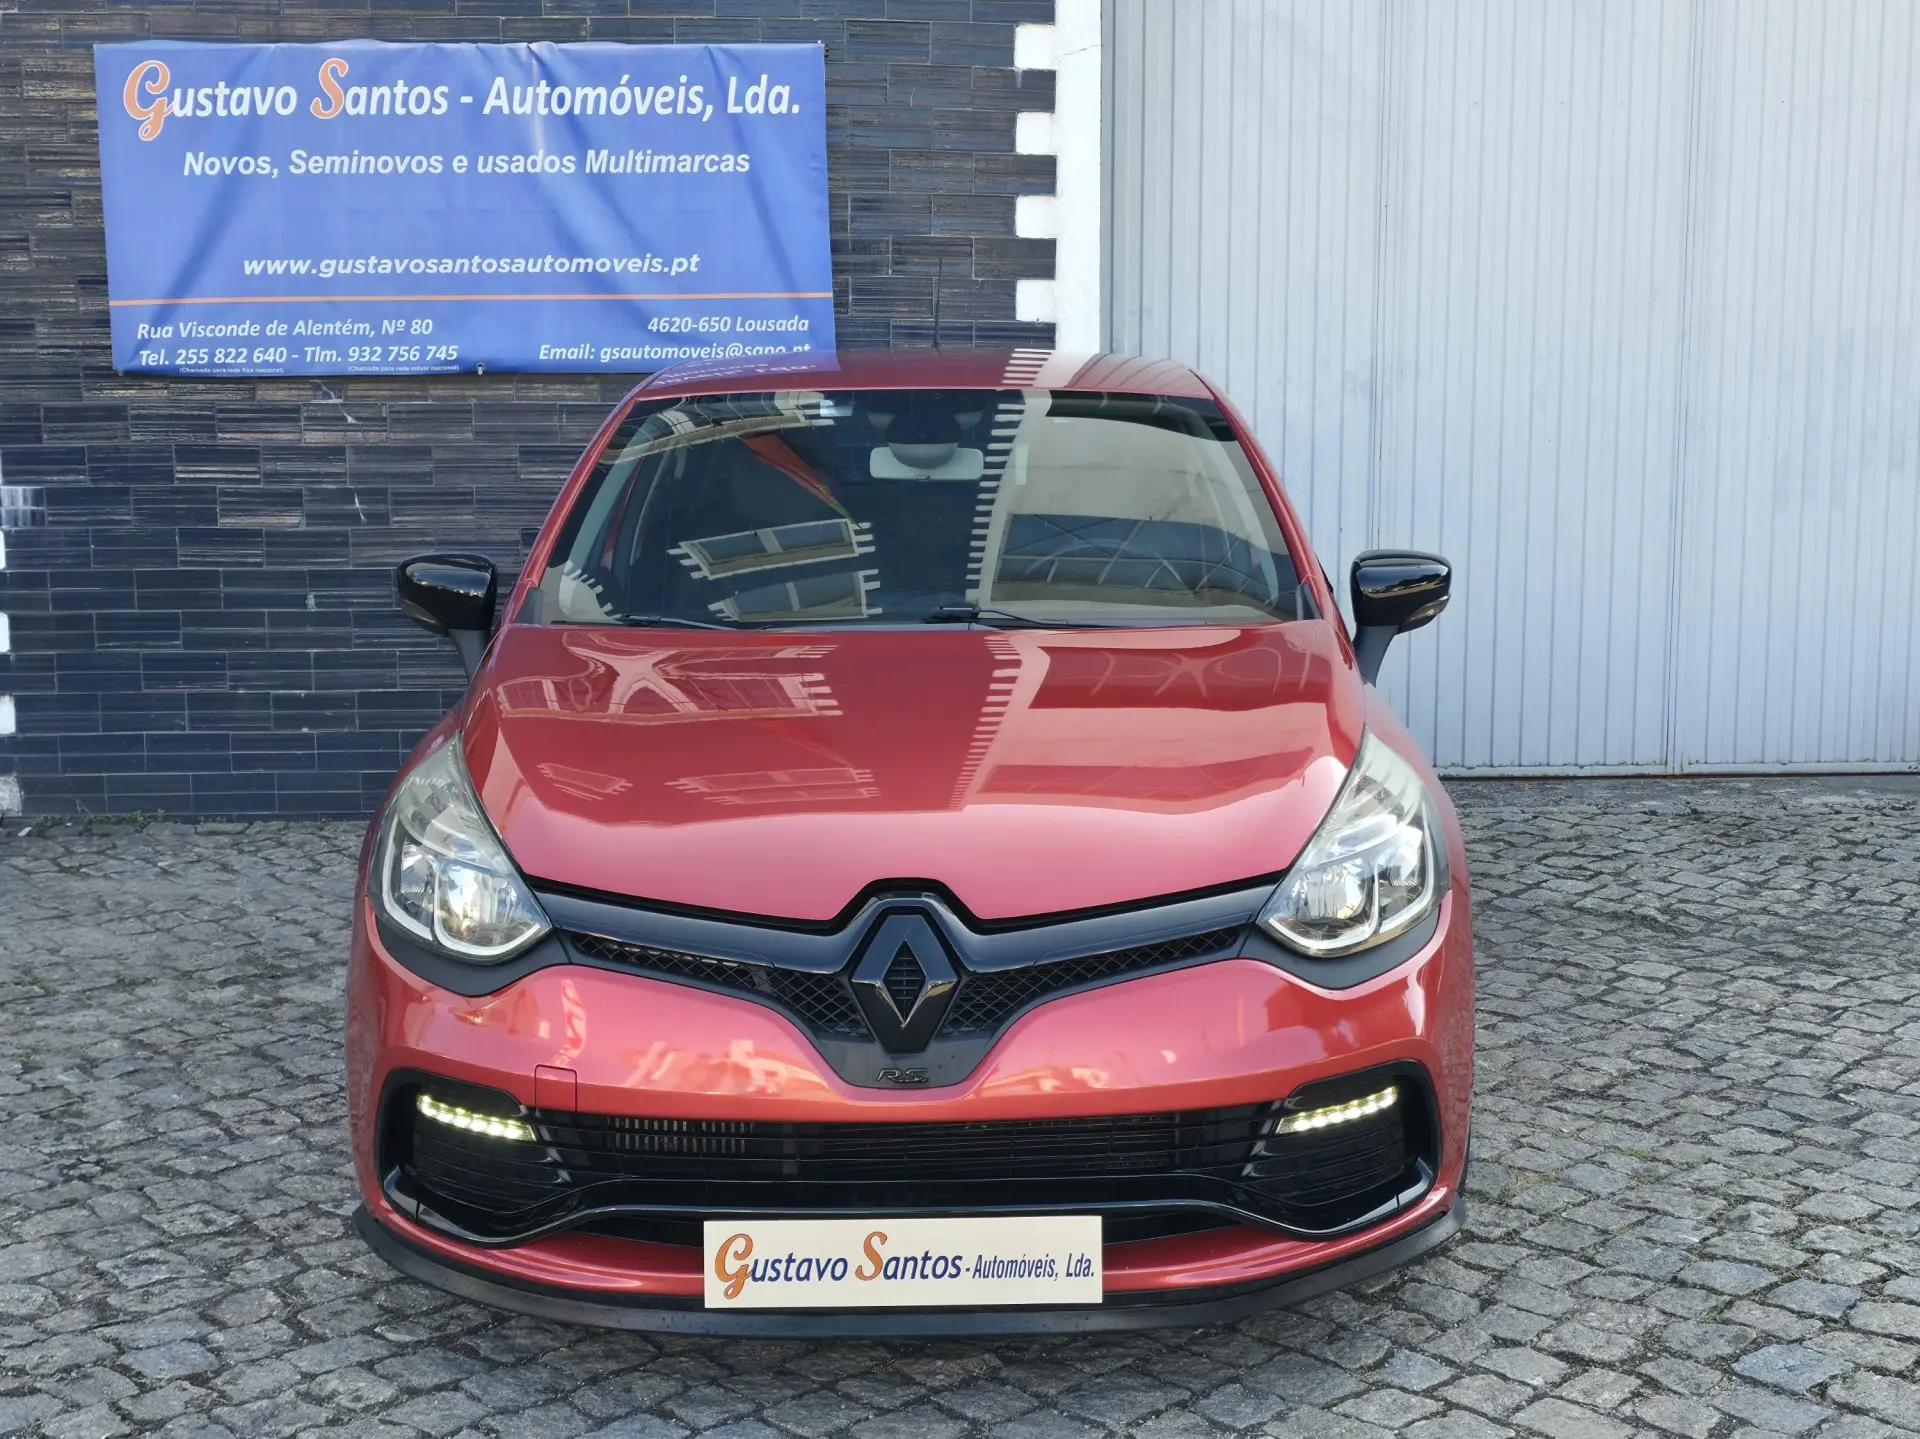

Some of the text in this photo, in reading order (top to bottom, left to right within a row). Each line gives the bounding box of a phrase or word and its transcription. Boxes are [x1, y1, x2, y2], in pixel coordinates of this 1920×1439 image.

[123, 57, 800, 141] Gustavo Santos - Automóveis, Lda.
[183, 149, 750, 178] Novos, Seminovos e usados Multimarcas
[243, 253, 700, 278] www.gustavosantosautomoveis.pt
[137, 323, 173, 339] Rua
[179, 319, 260, 338] Visconde
[265, 319, 288, 337] de
[292, 319, 375, 338] Alentém,
[410, 318, 433, 335] 80
[647, 315, 809, 333] 4620-650 Lousada
[139, 349, 169, 366] Tel.
[175, 348, 209, 365] 255
[214, 347, 248, 364] 822
[253, 347, 287, 363] 640
[304, 346, 342, 362] Tlm.
[348, 346, 382, 362] 932
[388, 346, 420, 361] 756
[425, 345, 458, 361] 745
[538, 342, 811, 363] Email: gsautomoveis@saot
[876, 1067, 929, 1084] RS
[714, 1232, 848, 1299] Gustavo
[854, 1231, 962, 1282] Santos
[972, 1253, 1059, 1282] Automóveis,
[1065, 1252, 1094, 1278] Lda.
